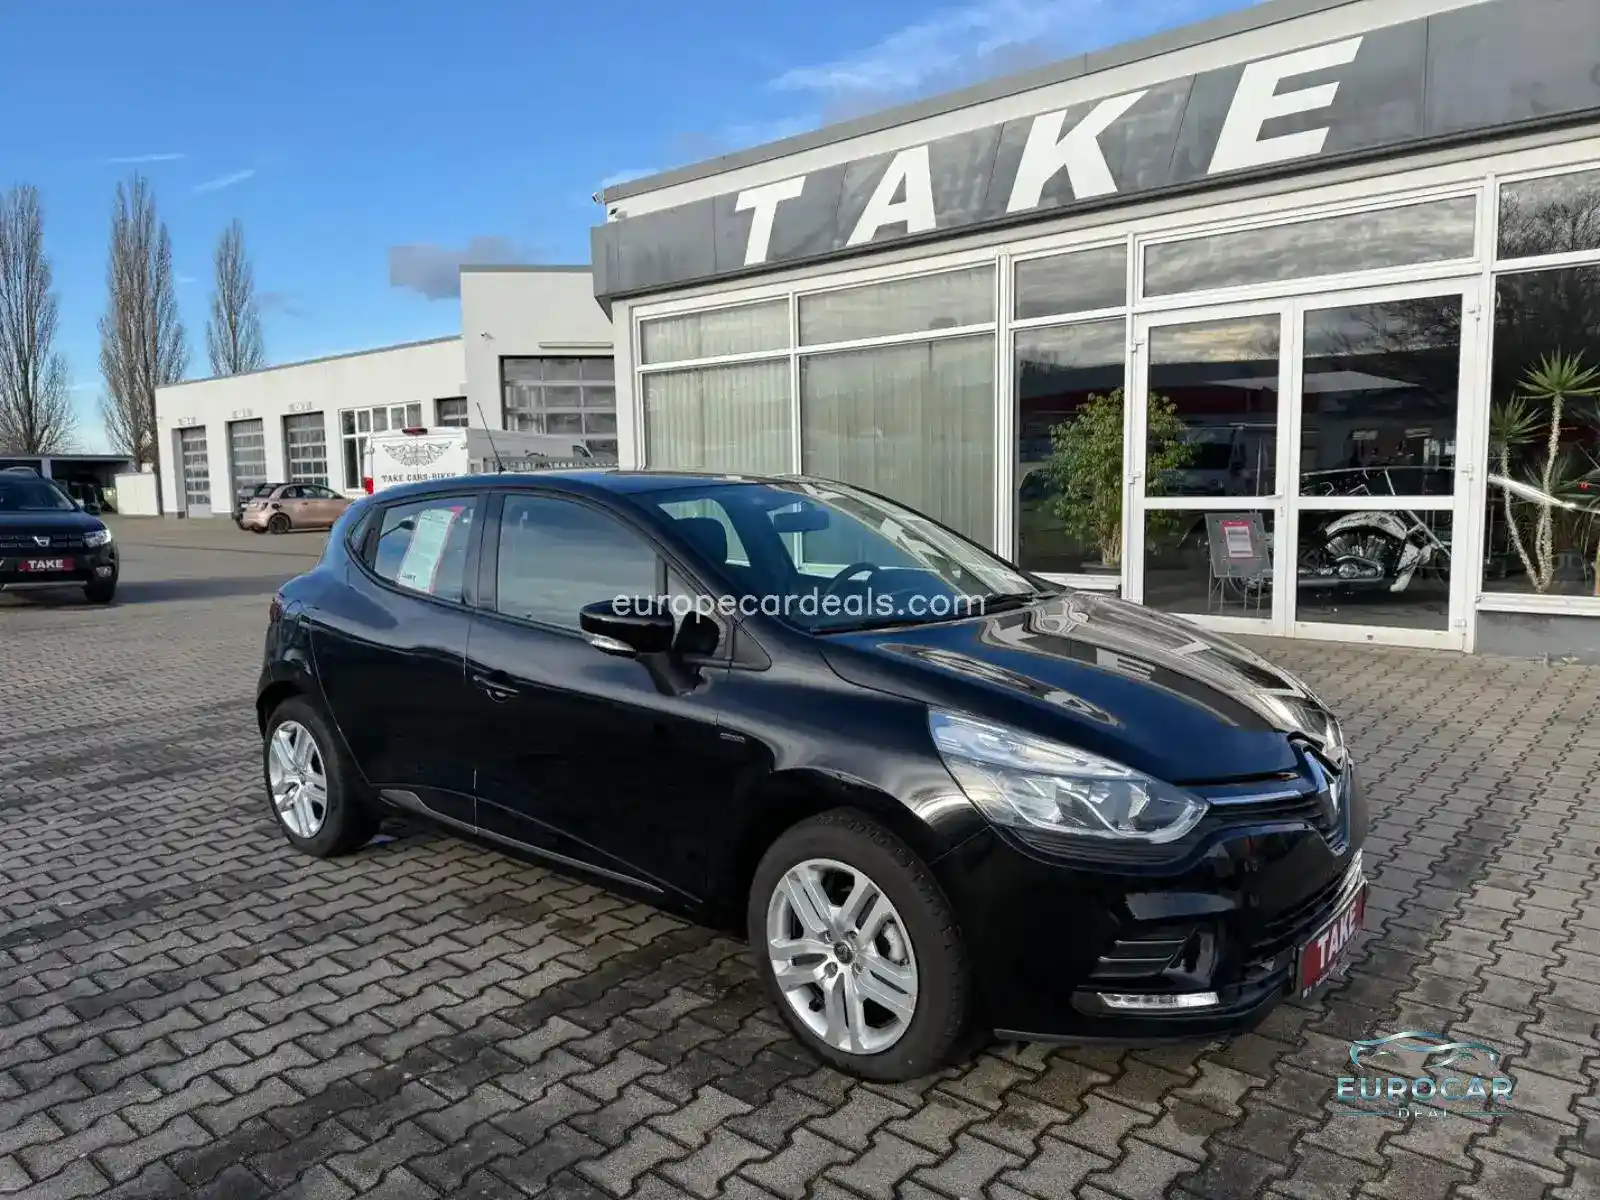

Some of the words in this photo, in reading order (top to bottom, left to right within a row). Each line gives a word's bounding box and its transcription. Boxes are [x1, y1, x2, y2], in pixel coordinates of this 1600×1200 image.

[734, 36, 1364, 267] TAKE
[380, 474, 404, 483] TAKE
[28, 559, 65, 569] TAKE
[1317, 900, 1357, 970] TAKE
